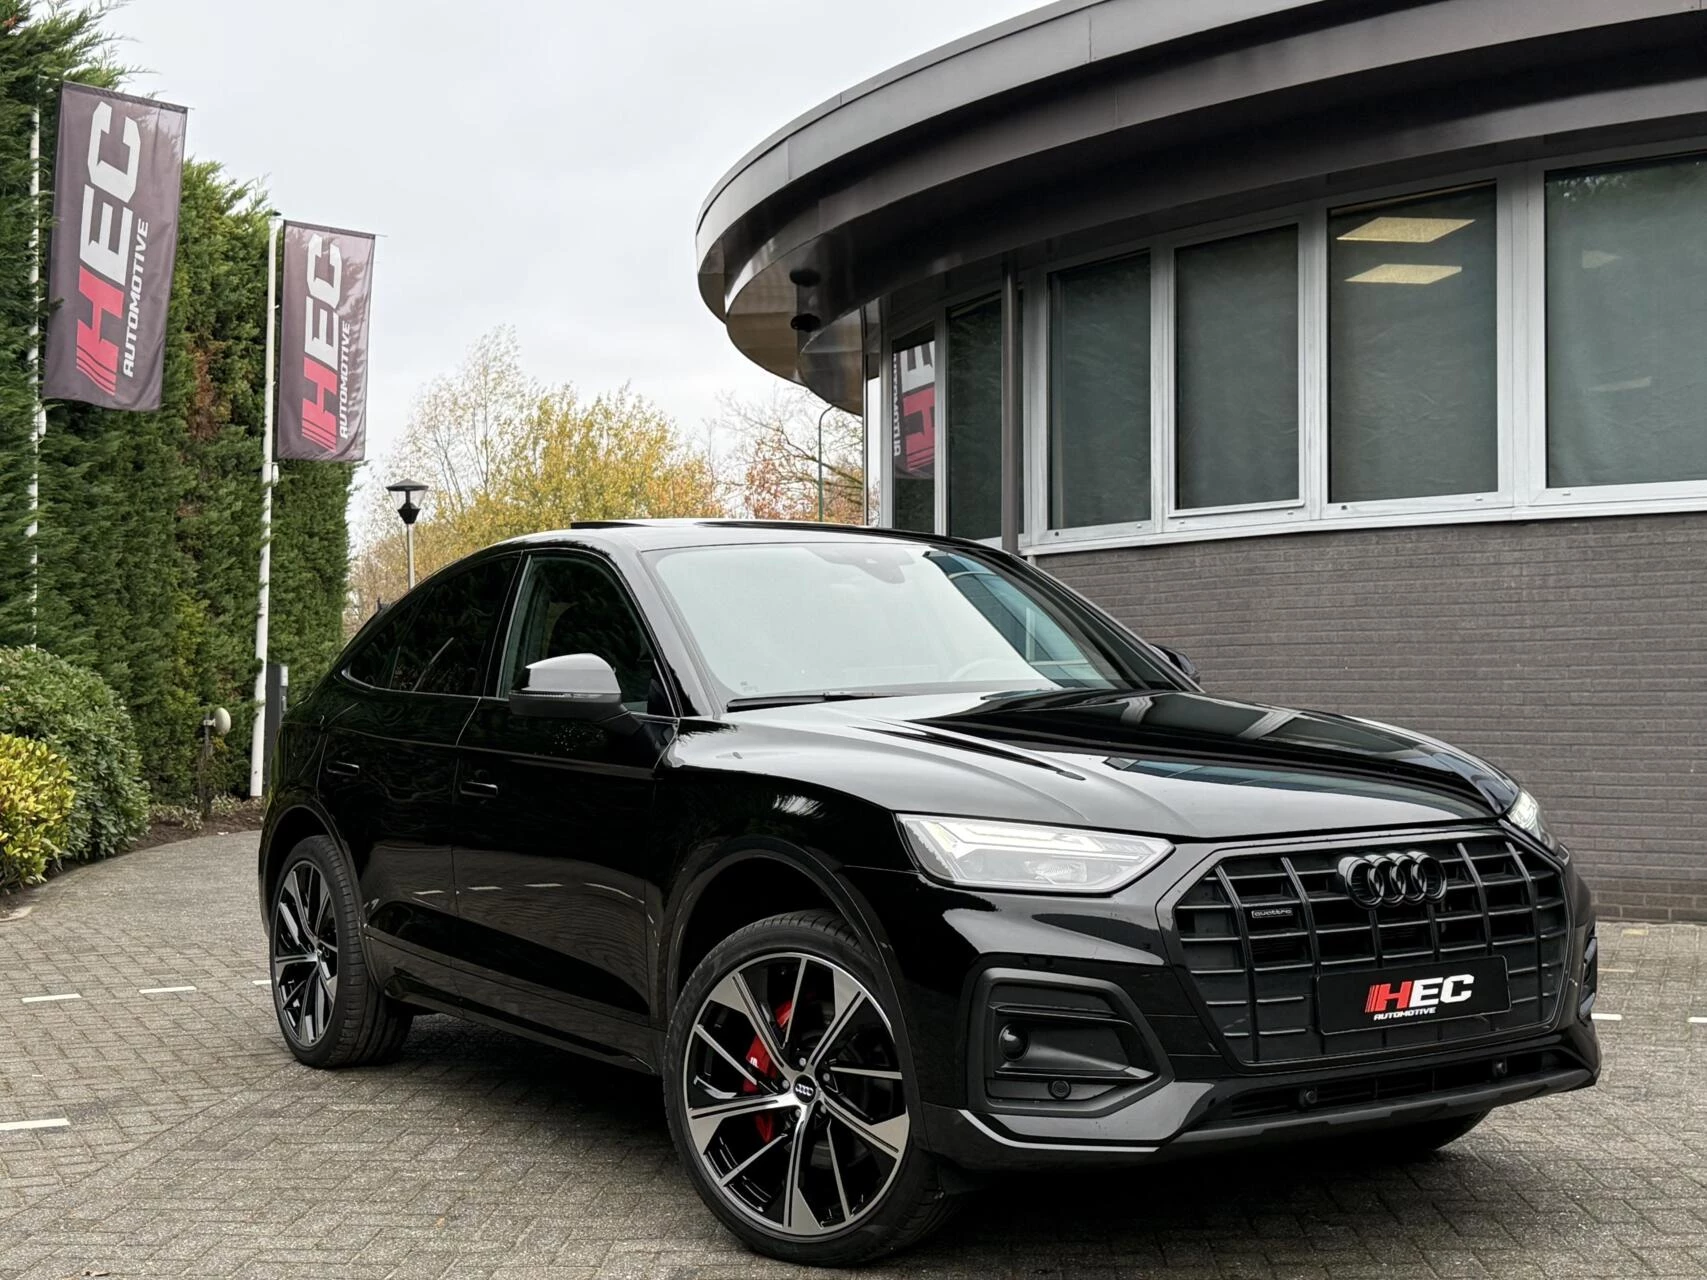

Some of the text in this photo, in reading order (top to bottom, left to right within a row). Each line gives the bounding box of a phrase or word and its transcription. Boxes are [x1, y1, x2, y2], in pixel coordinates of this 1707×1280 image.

[76, 101, 141, 396] HEC
[121, 218, 149, 378] AUTOMOTIVE
[301, 234, 343, 452] HEC
[339, 320, 351, 440] AUTOMOTIVE
[1364, 974, 1475, 1013] HEC
[1373, 1006, 1437, 1021] AUTOMOTIVE
